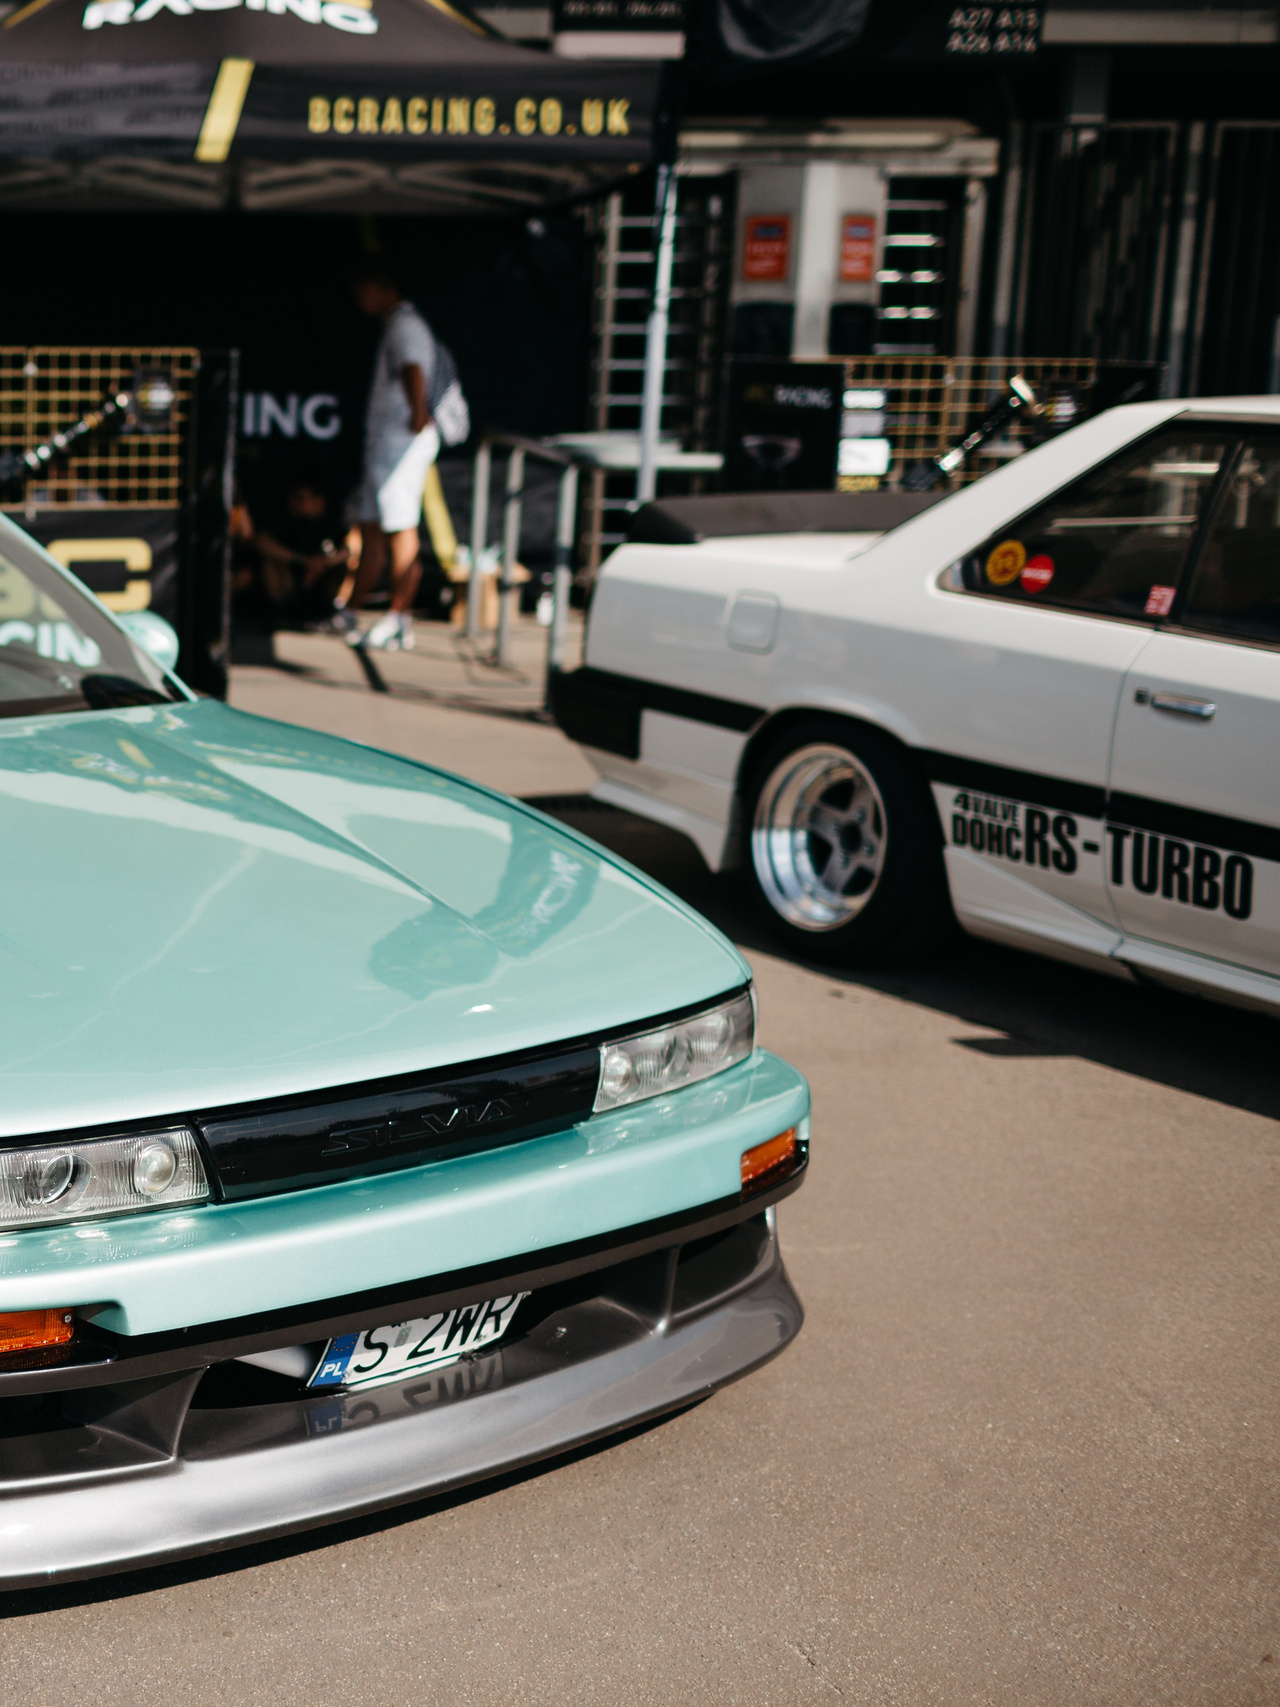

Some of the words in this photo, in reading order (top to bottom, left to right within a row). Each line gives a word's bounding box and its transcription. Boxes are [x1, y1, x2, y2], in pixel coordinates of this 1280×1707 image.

[308, 97, 629, 136] BCRACING.CO.UK
[243, 392, 341, 439] ING
[952, 813, 1021, 862] DOHC
[321, 1099, 515, 1157] SILVIA
[319, 1361, 343, 1379] PL
